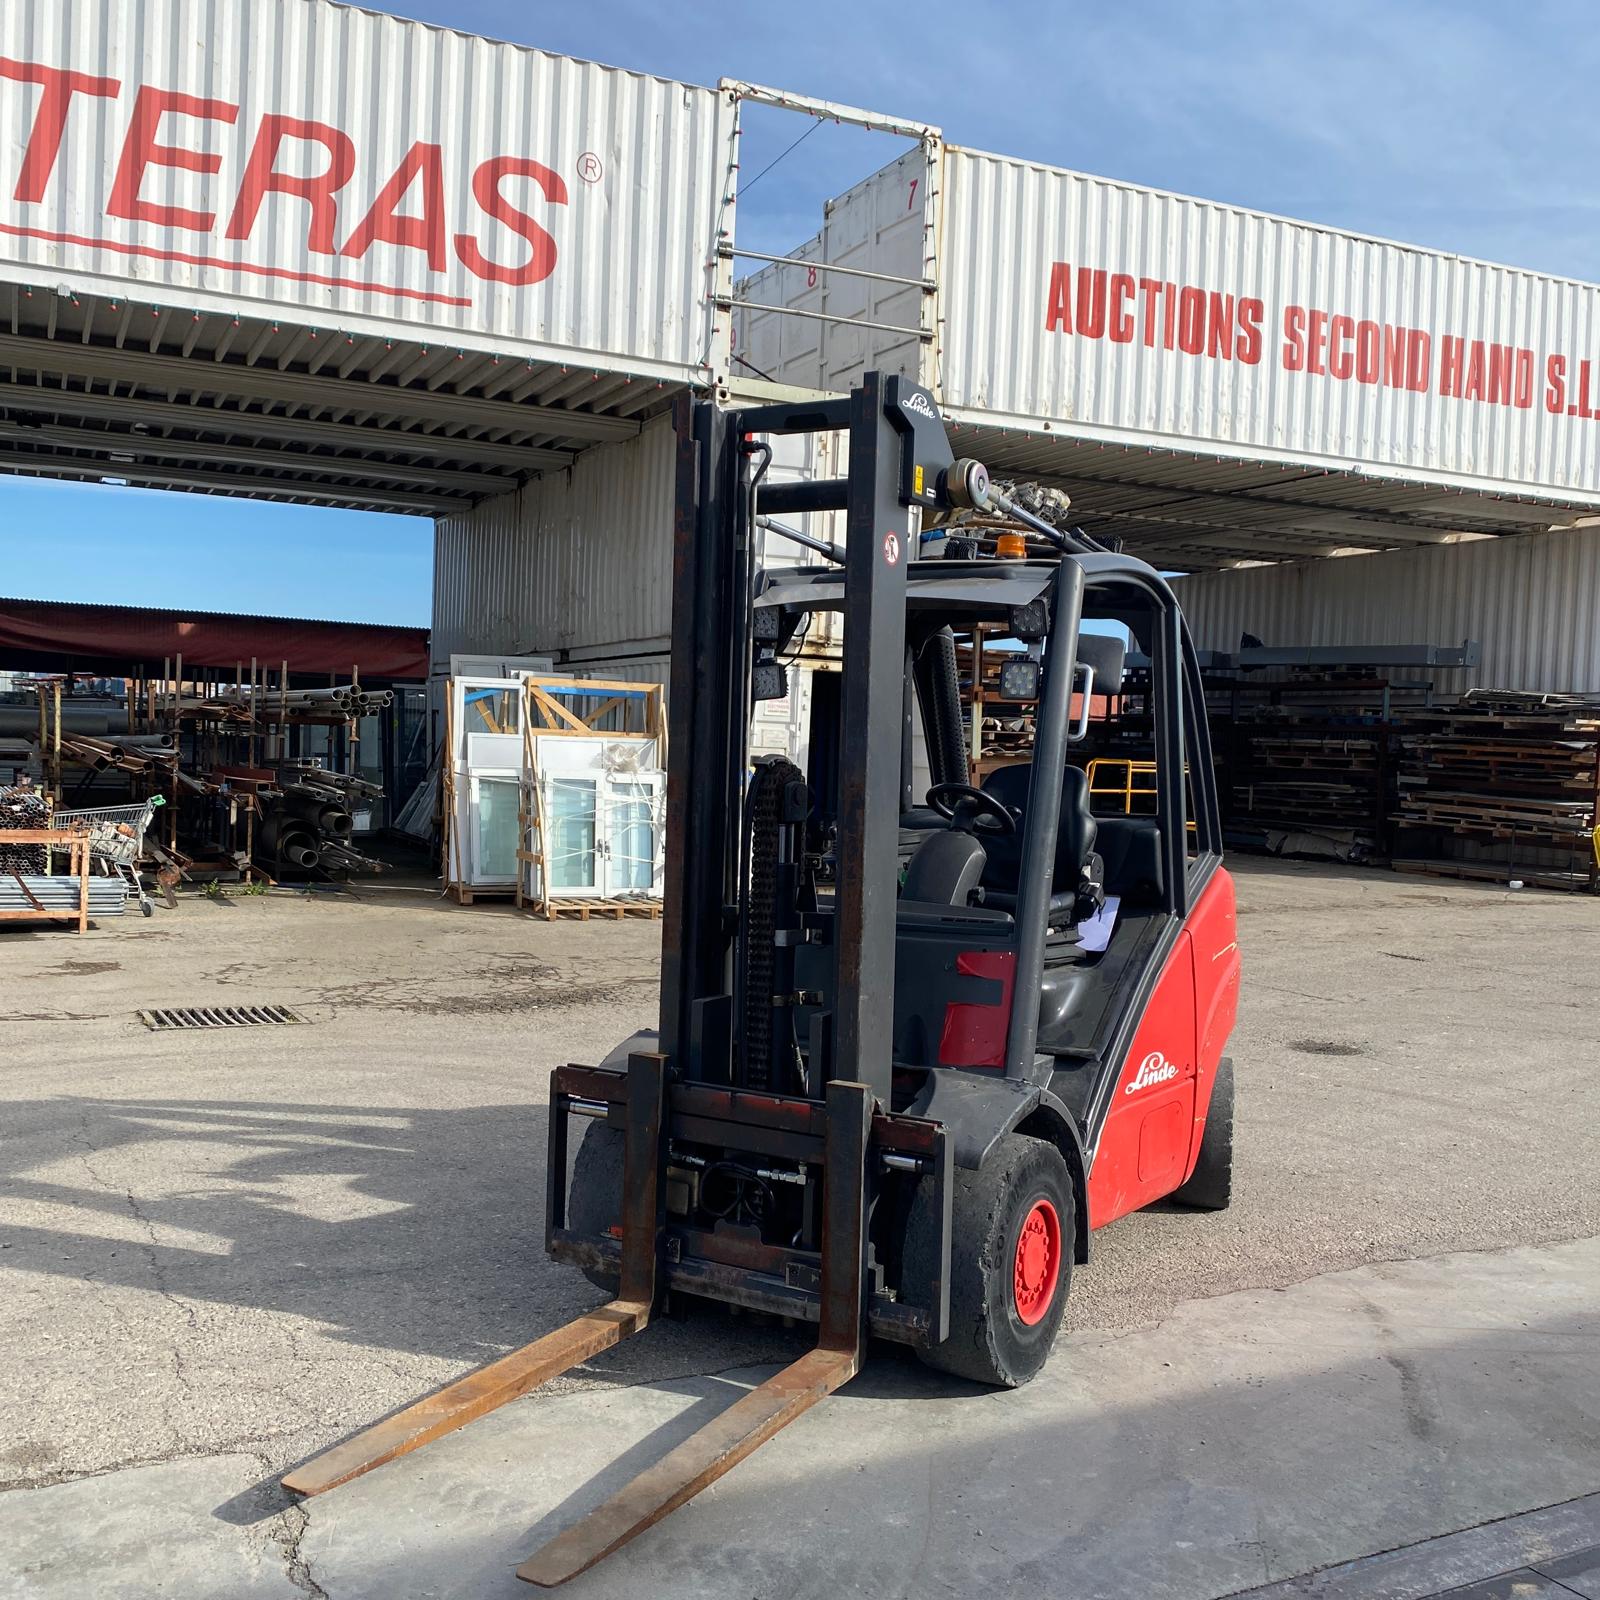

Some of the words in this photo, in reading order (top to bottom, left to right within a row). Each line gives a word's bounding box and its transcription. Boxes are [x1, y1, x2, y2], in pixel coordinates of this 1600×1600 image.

[0, 56, 568, 286] TERAS
[1045, 262, 1264, 366] AUCTIONS
[1282, 306, 1431, 393] SECOND
[1439, 335, 1534, 409] HAND
[1545, 355, 1600, 420] S.L.
[902, 392, 936, 418] Linde
[1125, 1052, 1179, 1095] Linde
